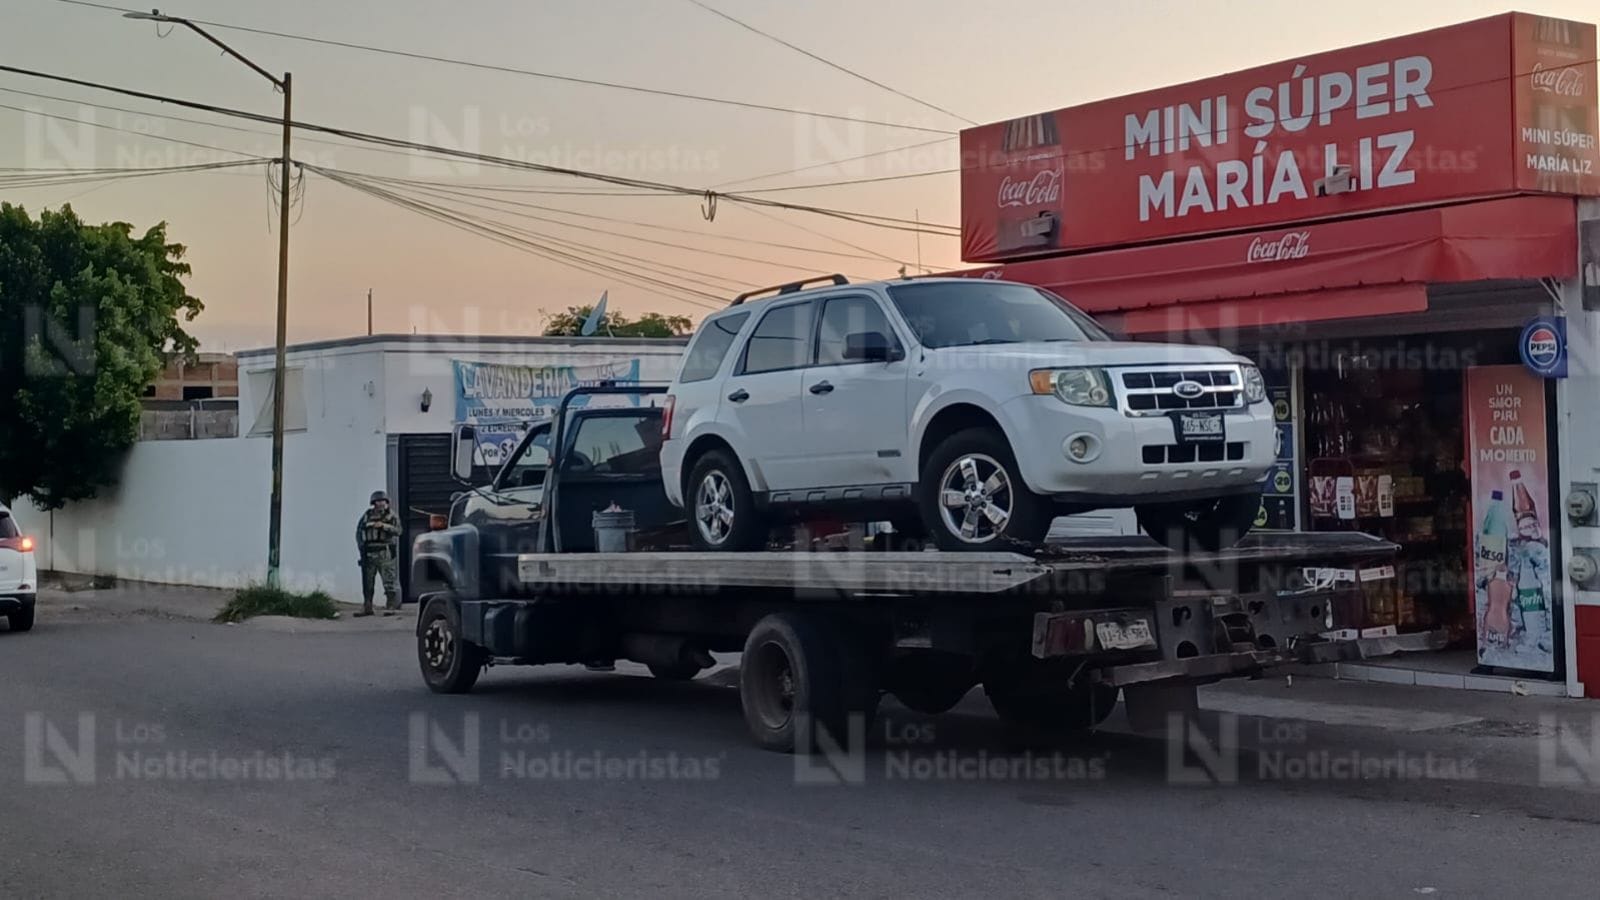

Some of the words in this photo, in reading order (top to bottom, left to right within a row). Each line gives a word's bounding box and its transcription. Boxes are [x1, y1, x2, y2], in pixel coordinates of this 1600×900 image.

[1124, 95, 1227, 161] MINI
[1244, 55, 1434, 138] SÚPER
[1521, 127, 1550, 145] MINI
[1553, 127, 1595, 150] SÚPER
[1526, 153, 1570, 173] MARÍA
[1572, 158, 1593, 175] LIZ
[1138, 140, 1309, 223] MARÍA
[1324, 130, 1415, 193] LIZ
[997, 169, 1062, 208] Coca-Cola
[1530, 343, 1556, 351] PEPSI
[1495, 383, 1513, 395] UN
[468, 407, 493, 417] LUNES
[1493, 410, 1518, 421] PARA
[1490, 426, 1525, 446] CADA
[1480, 448, 1536, 462] MOMENTO
